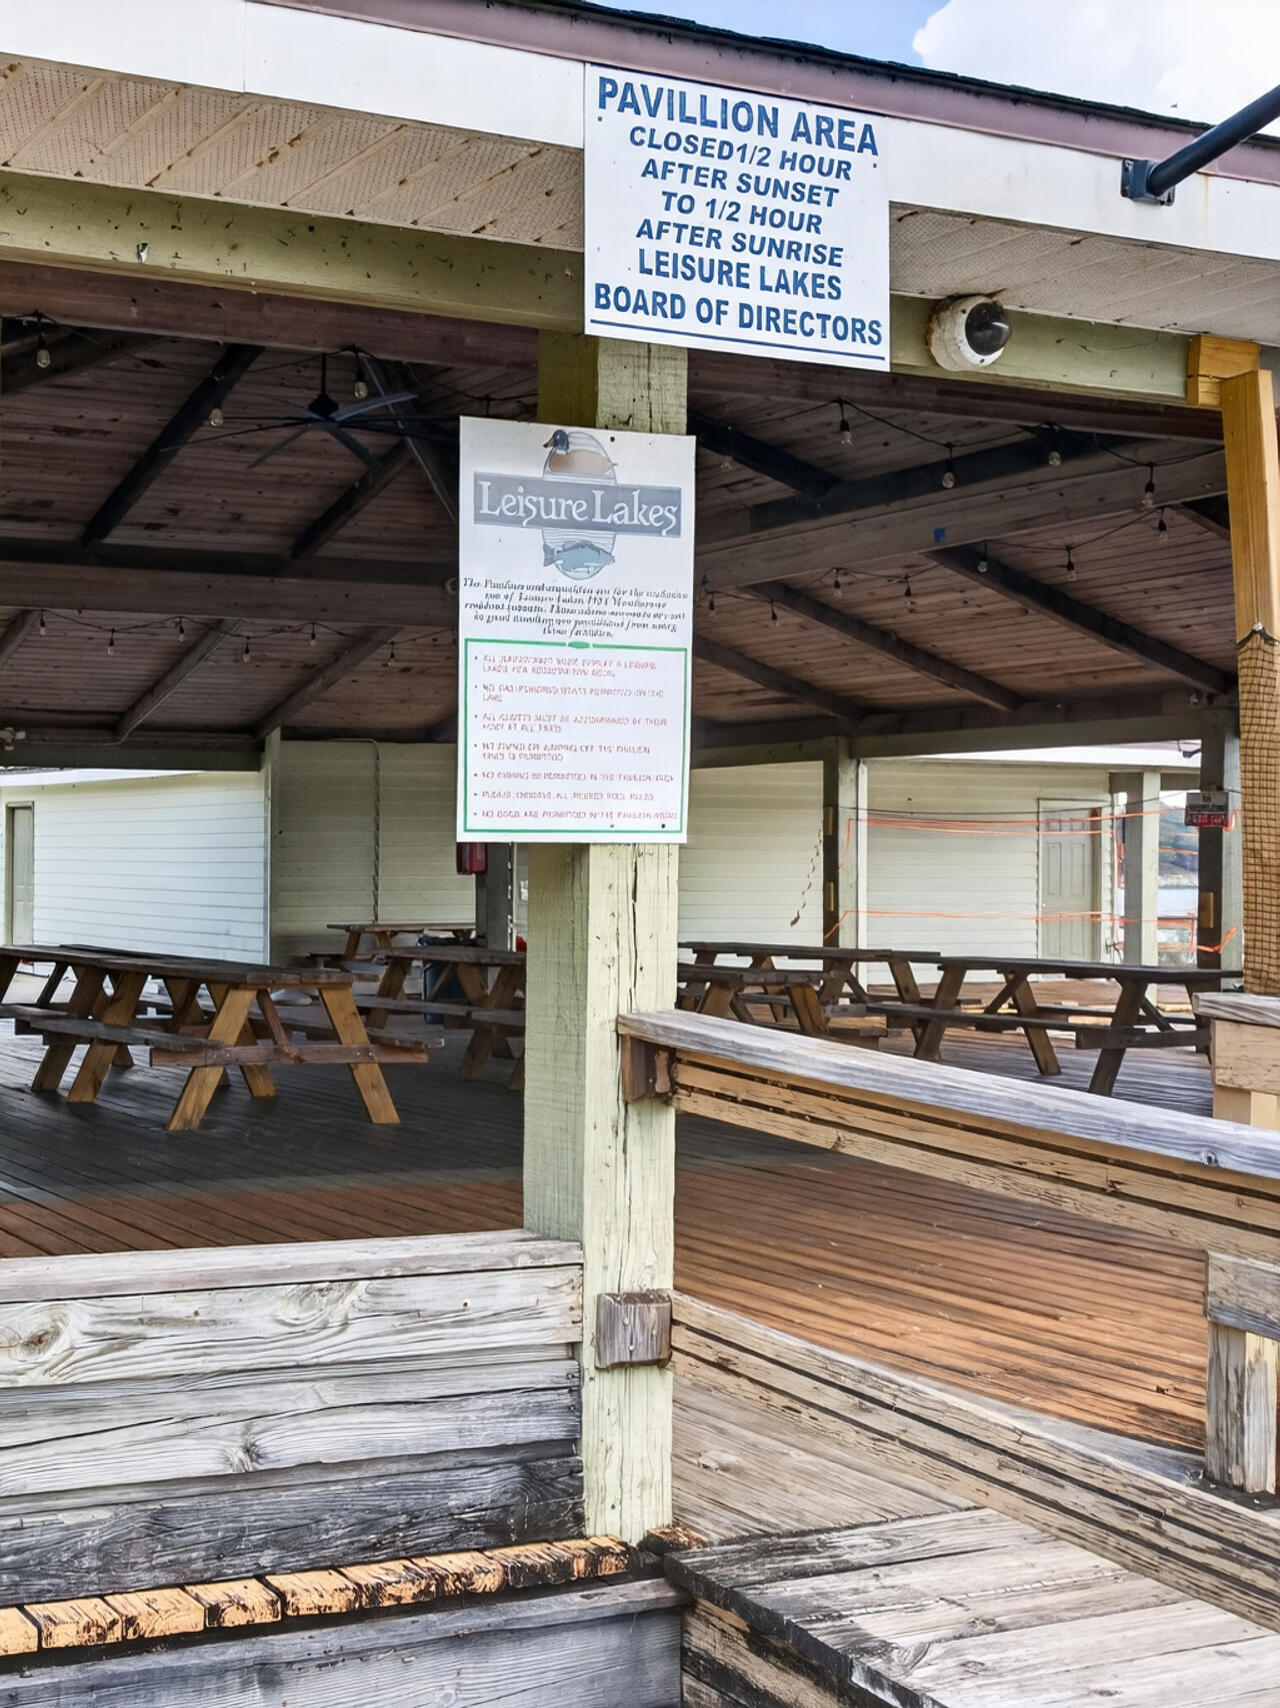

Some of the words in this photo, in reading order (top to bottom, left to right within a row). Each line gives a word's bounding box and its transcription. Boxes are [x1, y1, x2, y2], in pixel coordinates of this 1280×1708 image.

[598, 76, 779, 138] PAVILLION
[790, 111, 879, 156] AREA
[640, 158, 728, 191] AFTER
[735, 172, 840, 208] SUNSET
[779, 150, 852, 181] HOUR
[661, 190, 696, 215] TO
[705, 198, 741, 223] 1/2
[749, 204, 823, 235] HOUR
[635, 218, 723, 250] AFTER
[731, 232, 844, 268] SUNRISE
[639, 248, 750, 289] LEISURE
[759, 265, 842, 301] LAKES
[594, 282, 686, 320] BOARD
[695, 297, 729, 326] OF
[738, 302, 883, 346] DIRECTORS
[478, 481, 588, 527] Leisure
[591, 489, 678, 536] Lakes
